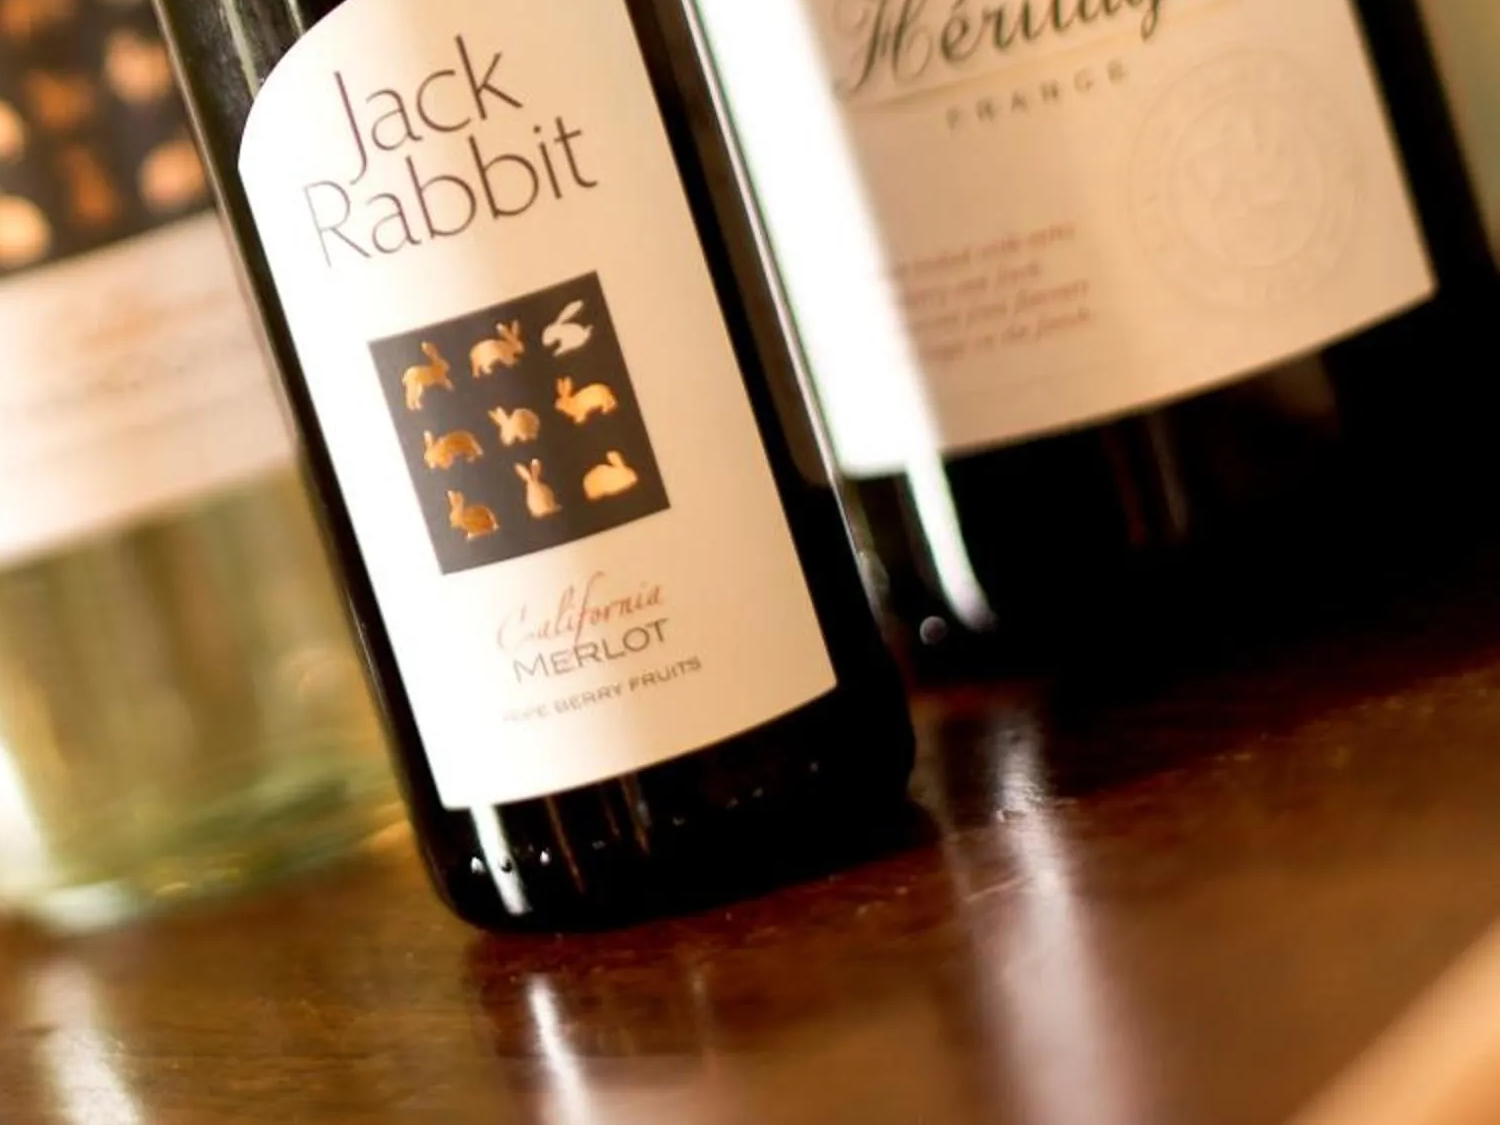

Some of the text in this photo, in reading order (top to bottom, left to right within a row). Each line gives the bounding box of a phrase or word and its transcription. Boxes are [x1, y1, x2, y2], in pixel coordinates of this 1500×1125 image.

[332, 34, 524, 186] Jack
[944, 59, 1129, 130] FRANCE
[303, 115, 599, 268] Rabbit
[495, 570, 665, 651] California
[512, 617, 670, 684] MERLOT
[553, 681, 623, 715] BERRY
[628, 654, 703, 693] FRUITS
